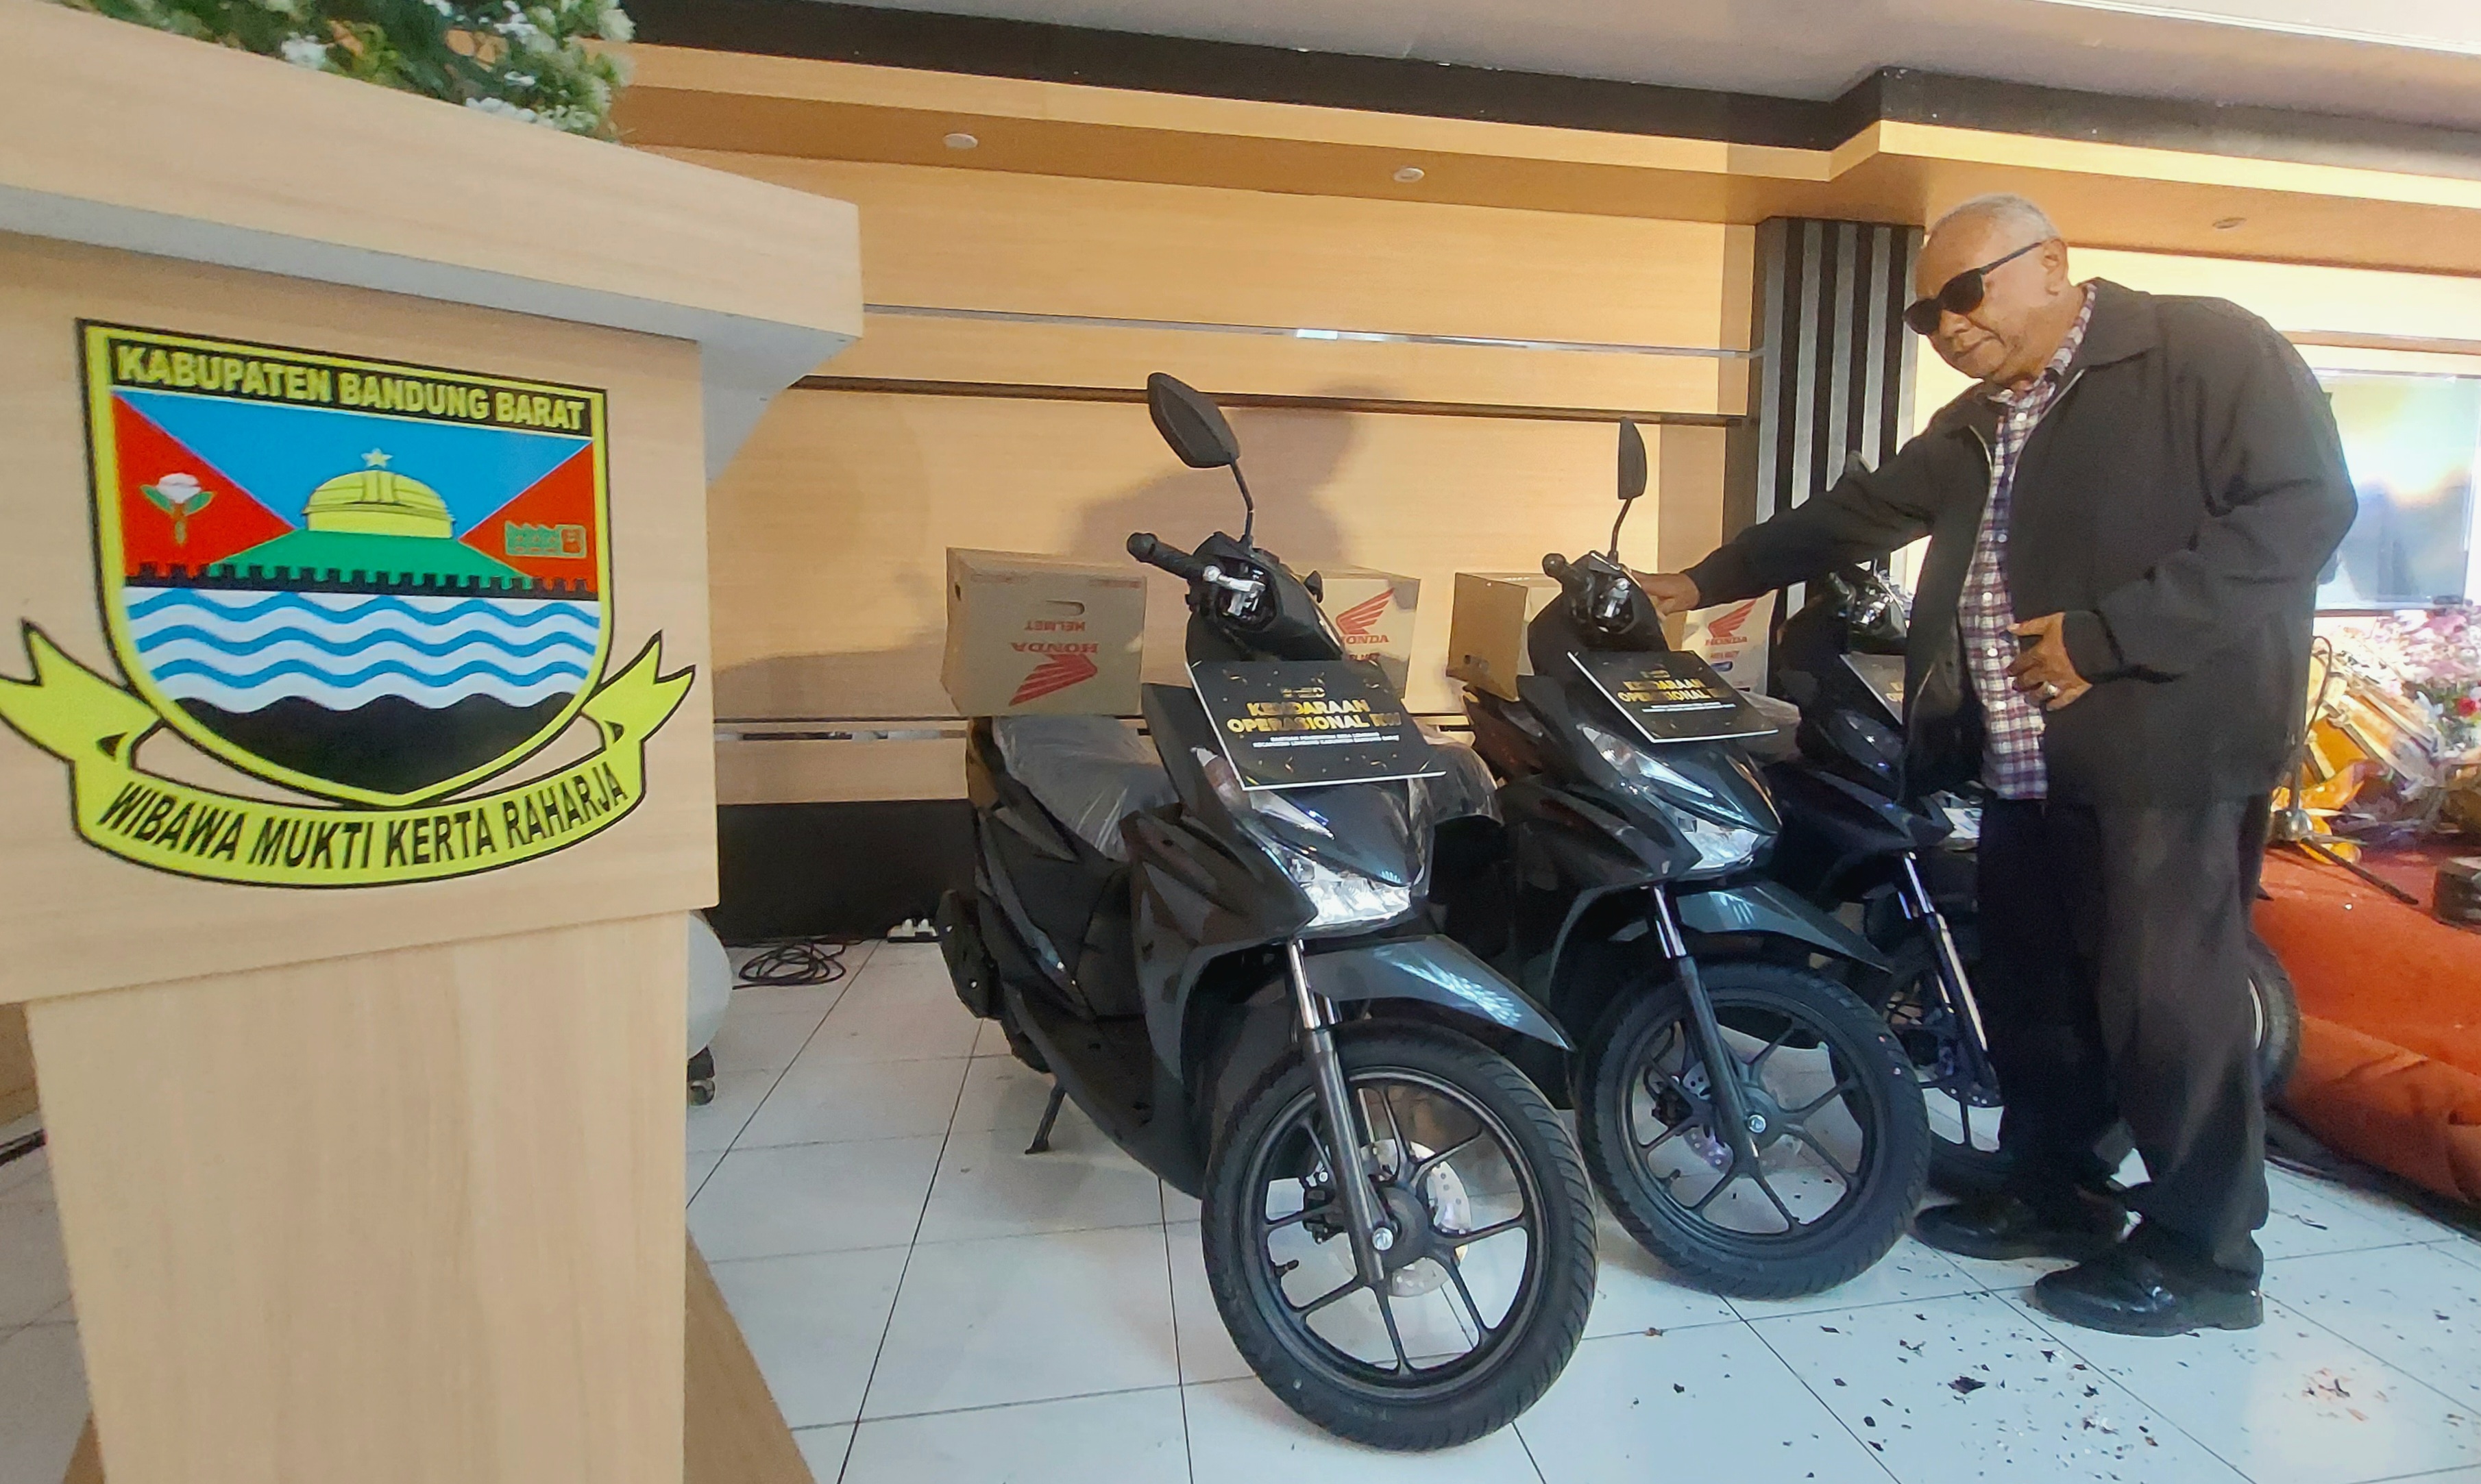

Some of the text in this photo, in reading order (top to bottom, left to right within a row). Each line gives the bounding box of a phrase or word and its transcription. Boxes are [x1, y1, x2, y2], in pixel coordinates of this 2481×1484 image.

[117, 345, 585, 430] KABUPATEN BANDUNG BARAT
[1010, 642, 1099, 654] HONDA
[1341, 634, 1390, 645] ONDA
[1226, 714, 1371, 733] OPERASIONAL
[96, 760, 628, 870] WIBAWA MUKTI KERTA RAHARJA
